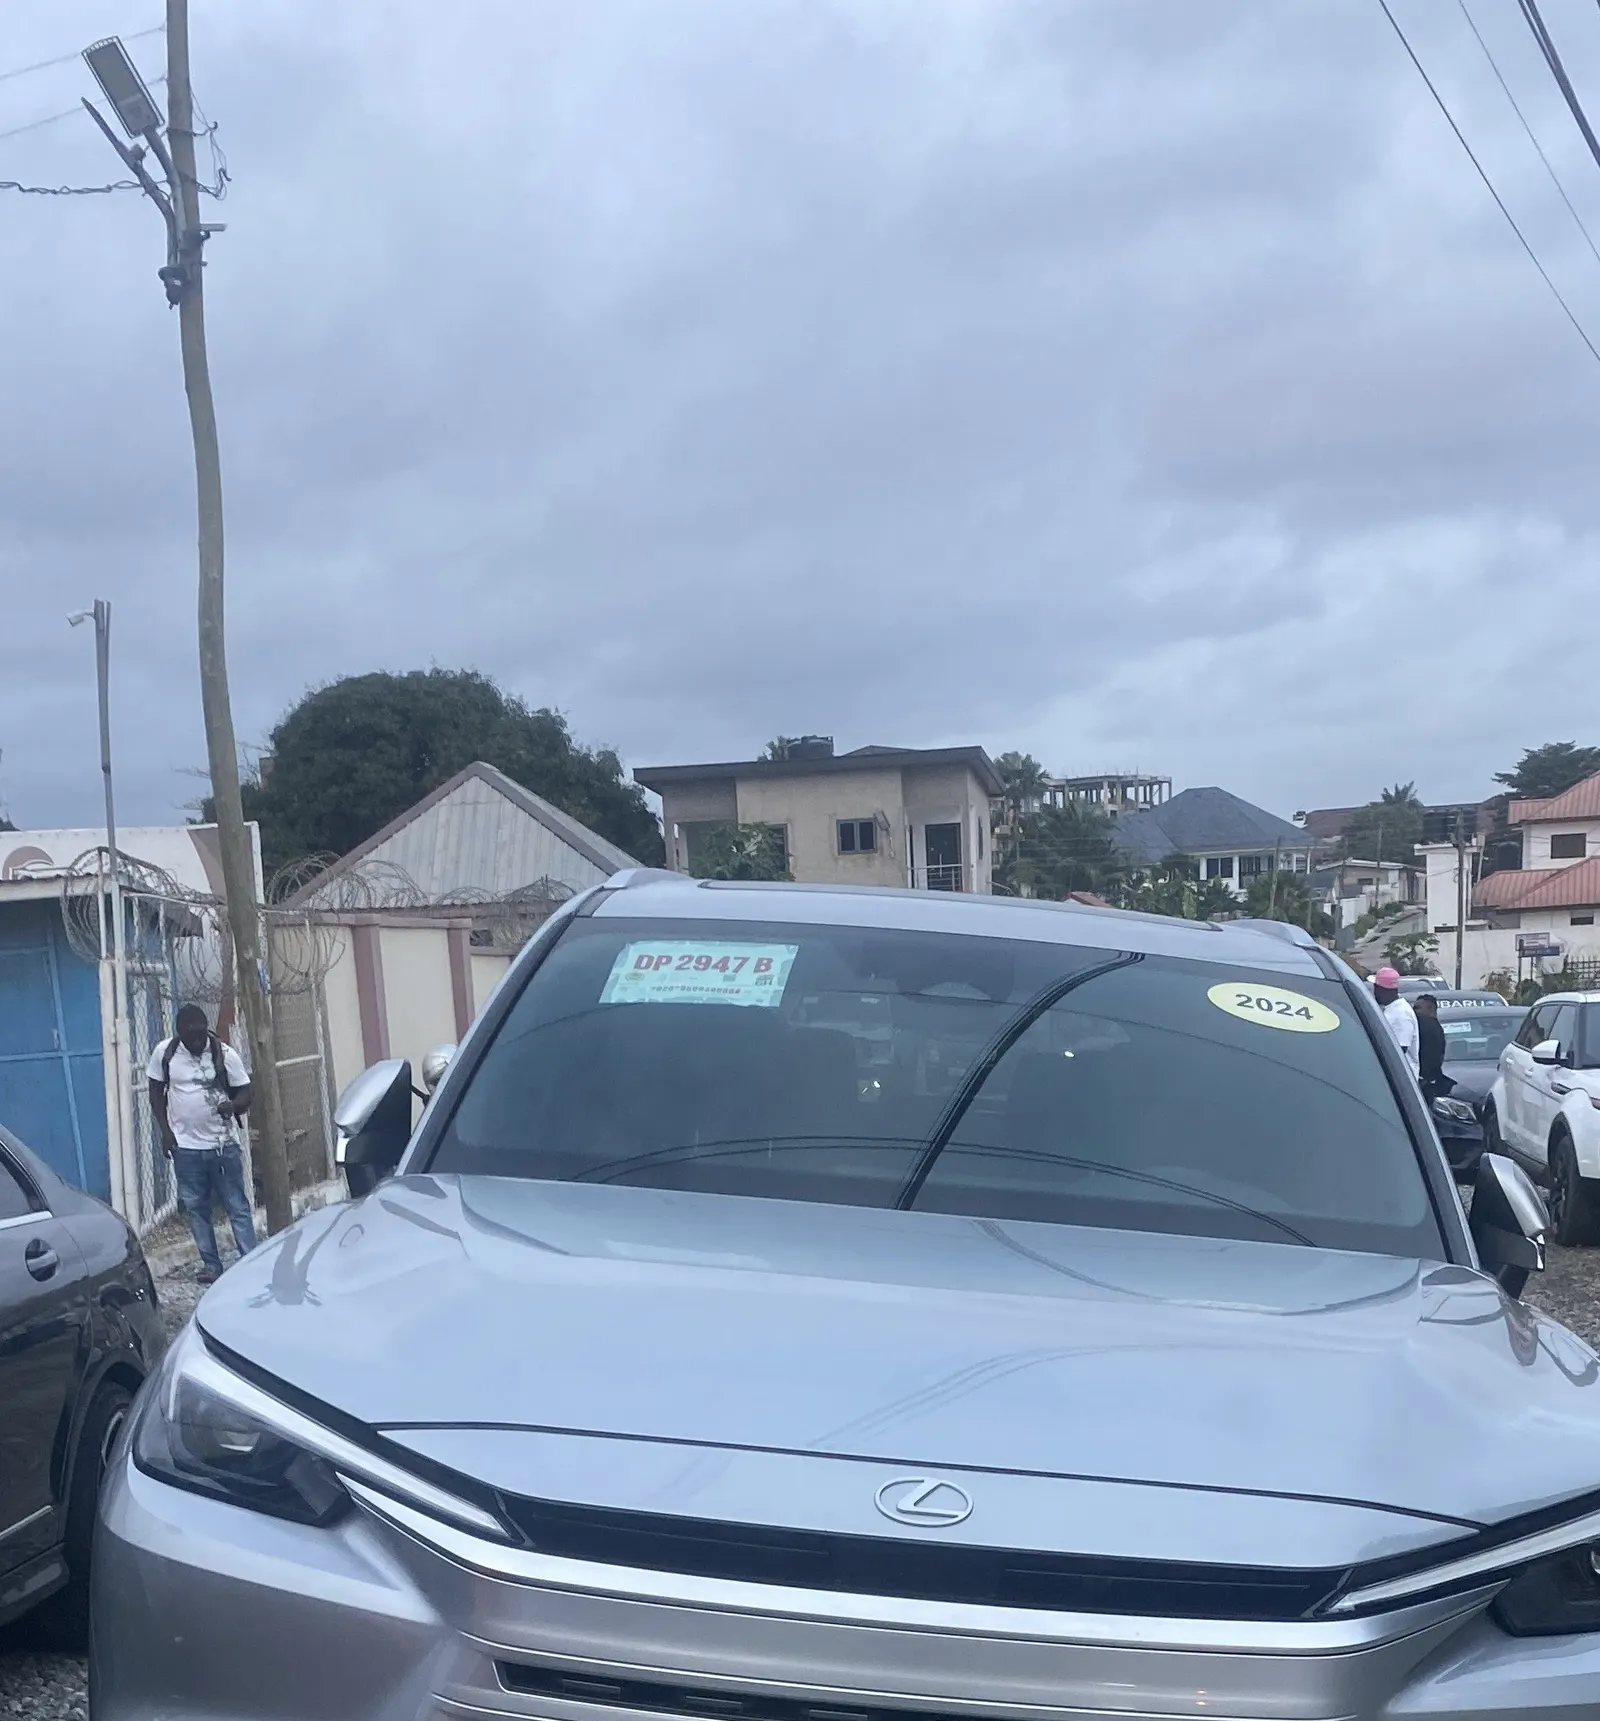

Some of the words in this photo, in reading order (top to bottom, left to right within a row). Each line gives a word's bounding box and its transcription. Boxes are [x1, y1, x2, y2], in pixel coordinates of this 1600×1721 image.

[633, 954, 672, 971] DP
[675, 954, 750, 974] 2947
[753, 957, 774, 973] B
[1235, 993, 1314, 1021] 2024
[1437, 1000, 1485, 1009] BARU
